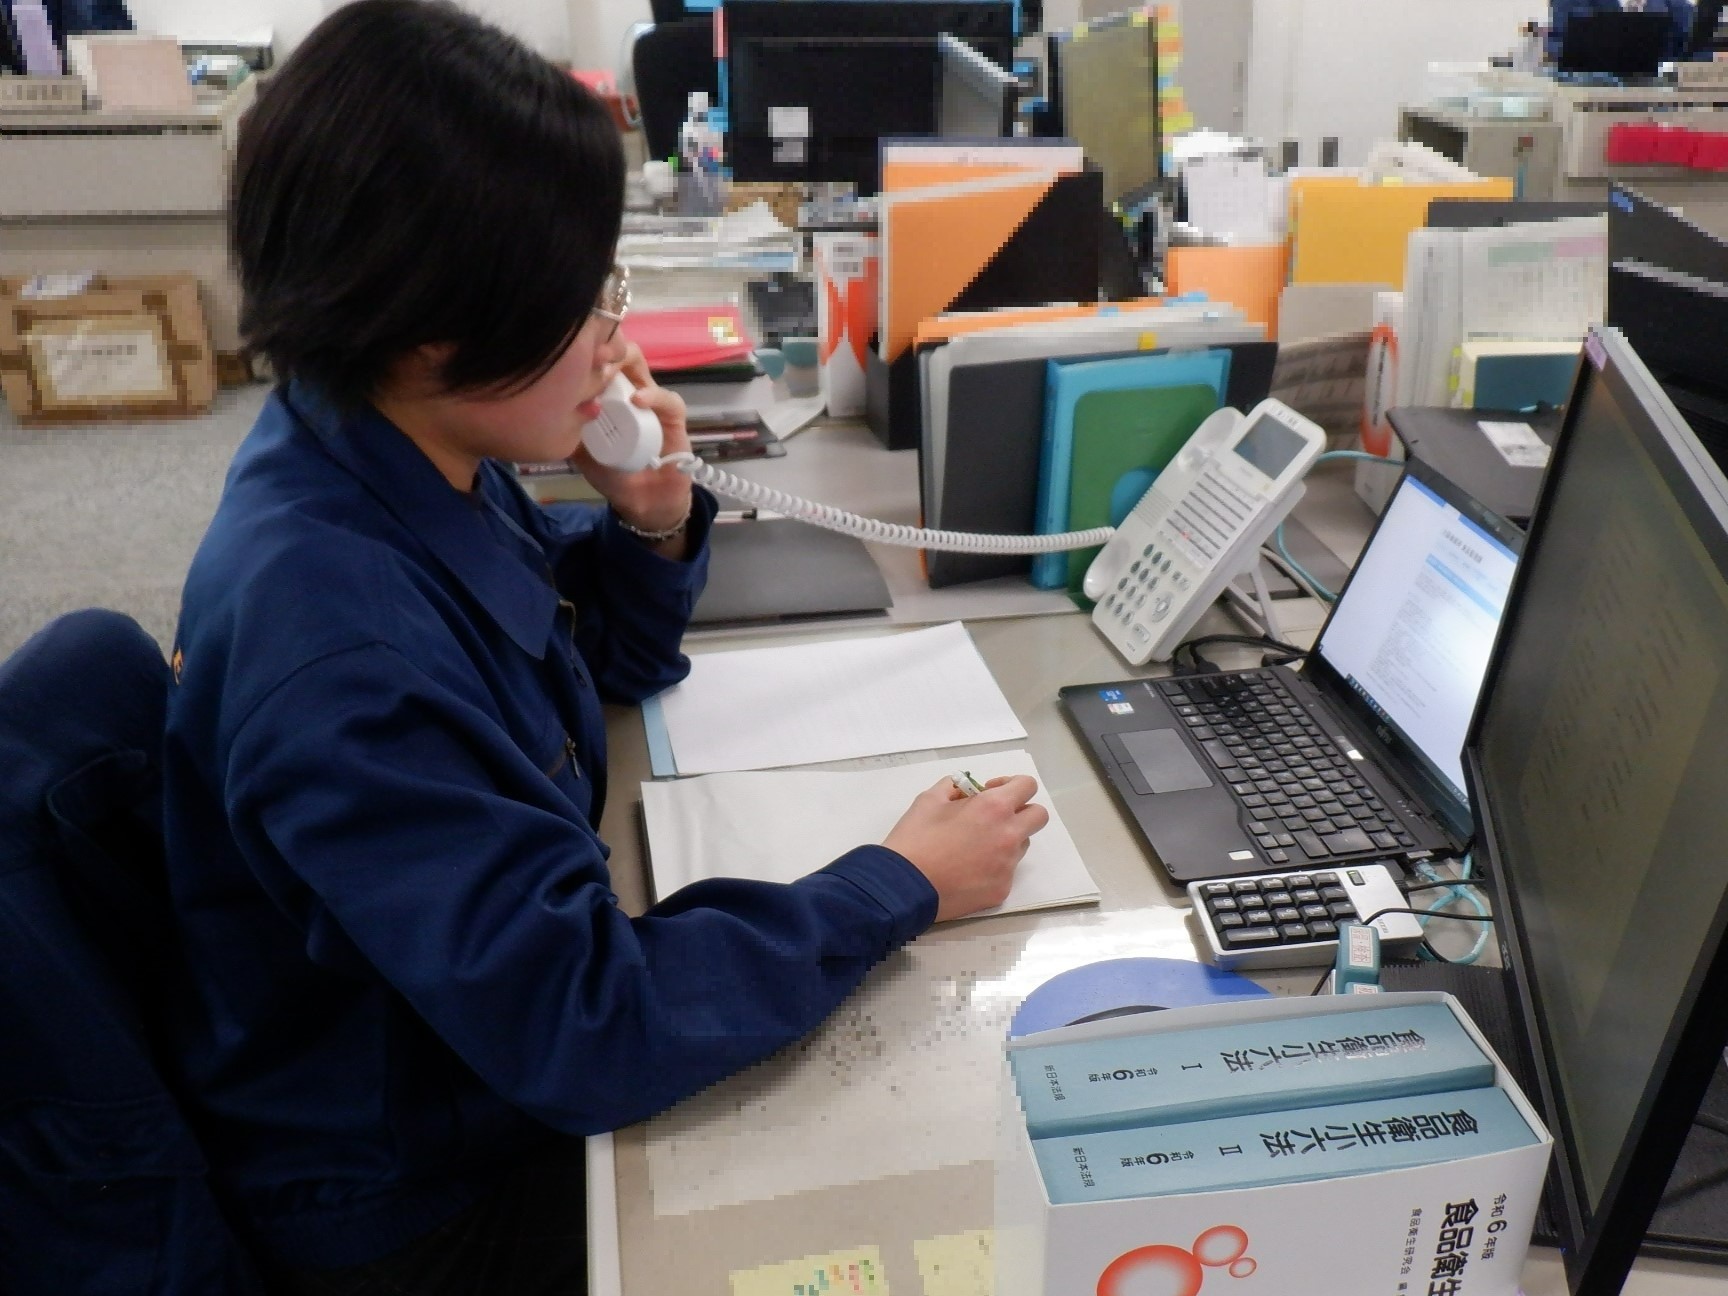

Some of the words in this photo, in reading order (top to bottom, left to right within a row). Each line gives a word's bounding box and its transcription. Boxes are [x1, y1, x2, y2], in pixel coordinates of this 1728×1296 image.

[1088, 1067, 1158, 1083] 令和6年版
[1259, 1109, 1479, 1158] 食品衛生小六法
[1119, 1150, 1195, 1168] 令和6年版
[1481, 1192, 1508, 1261] 令和6年版
